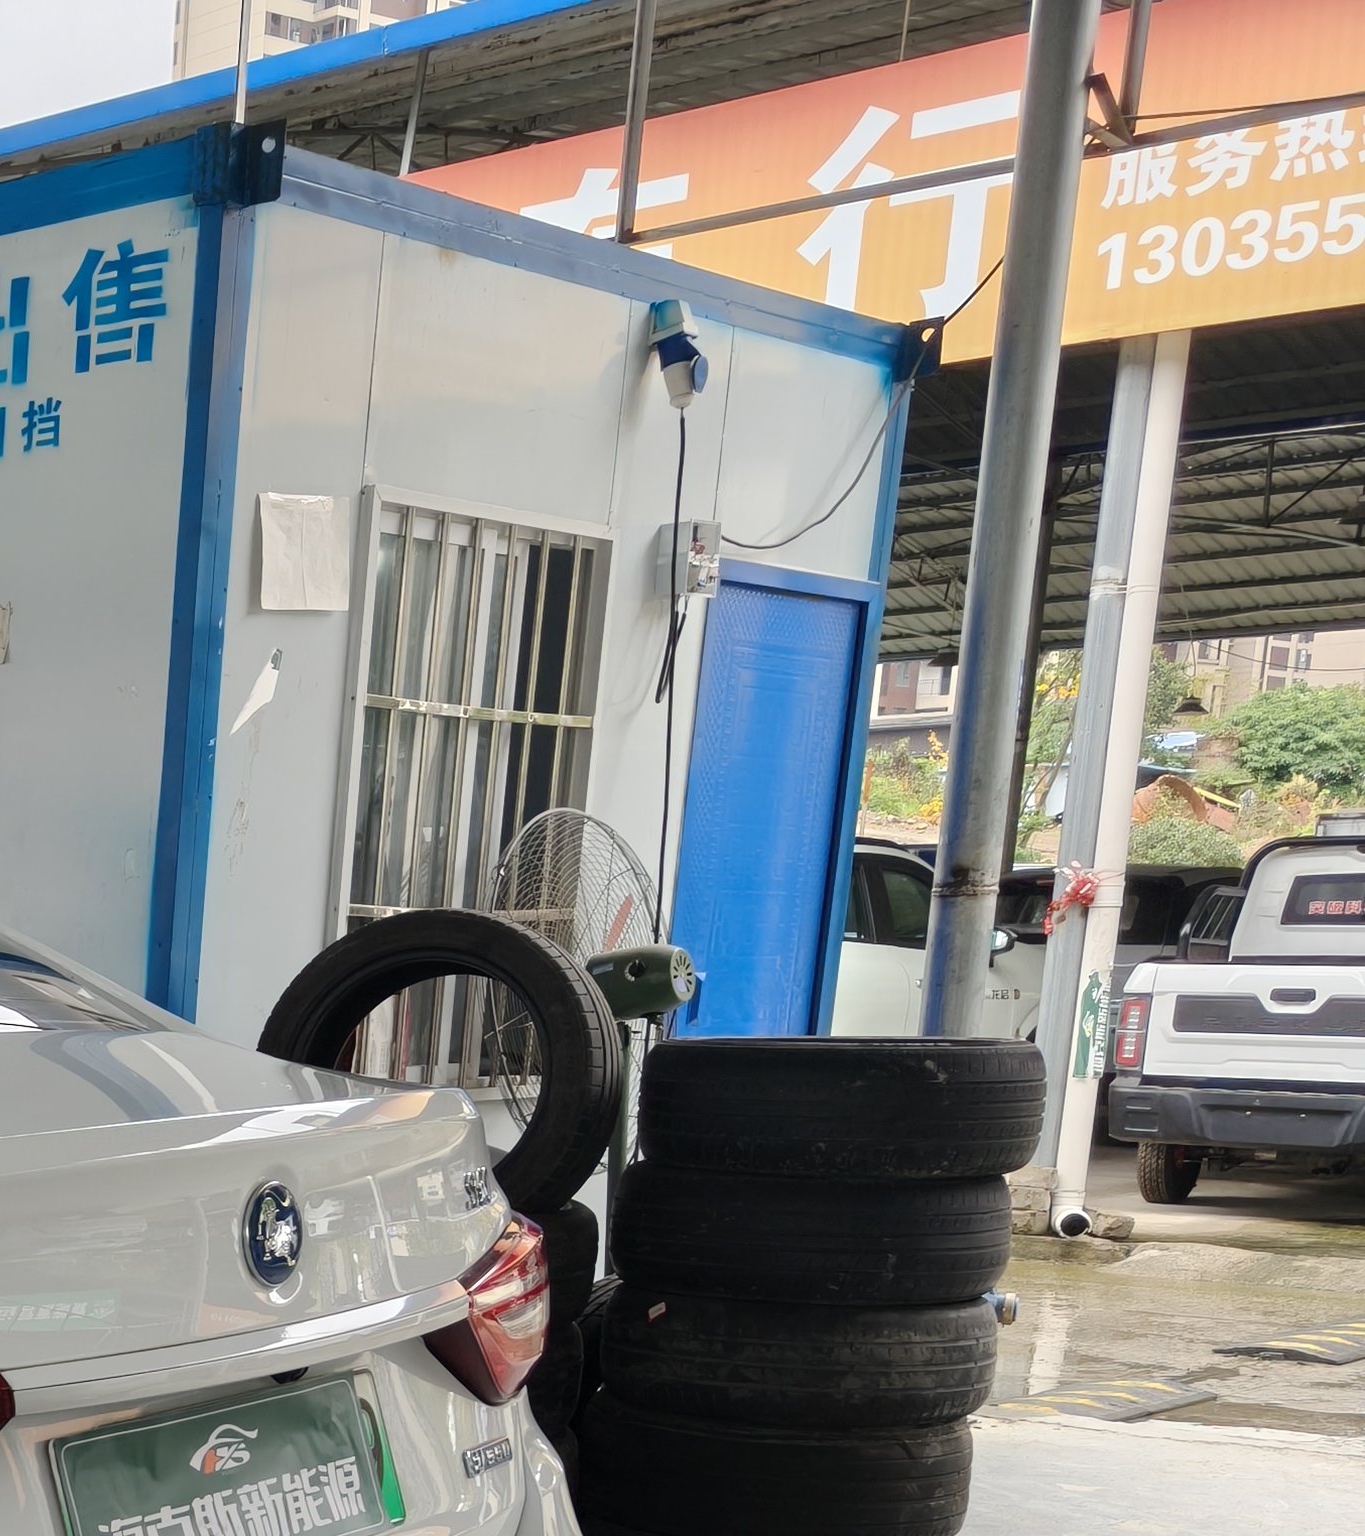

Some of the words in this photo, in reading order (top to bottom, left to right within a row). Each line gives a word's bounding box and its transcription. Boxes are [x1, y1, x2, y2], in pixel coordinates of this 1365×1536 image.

[1101, 108, 1365, 210] 服务热
[1096, 193, 1365, 291] 130355
